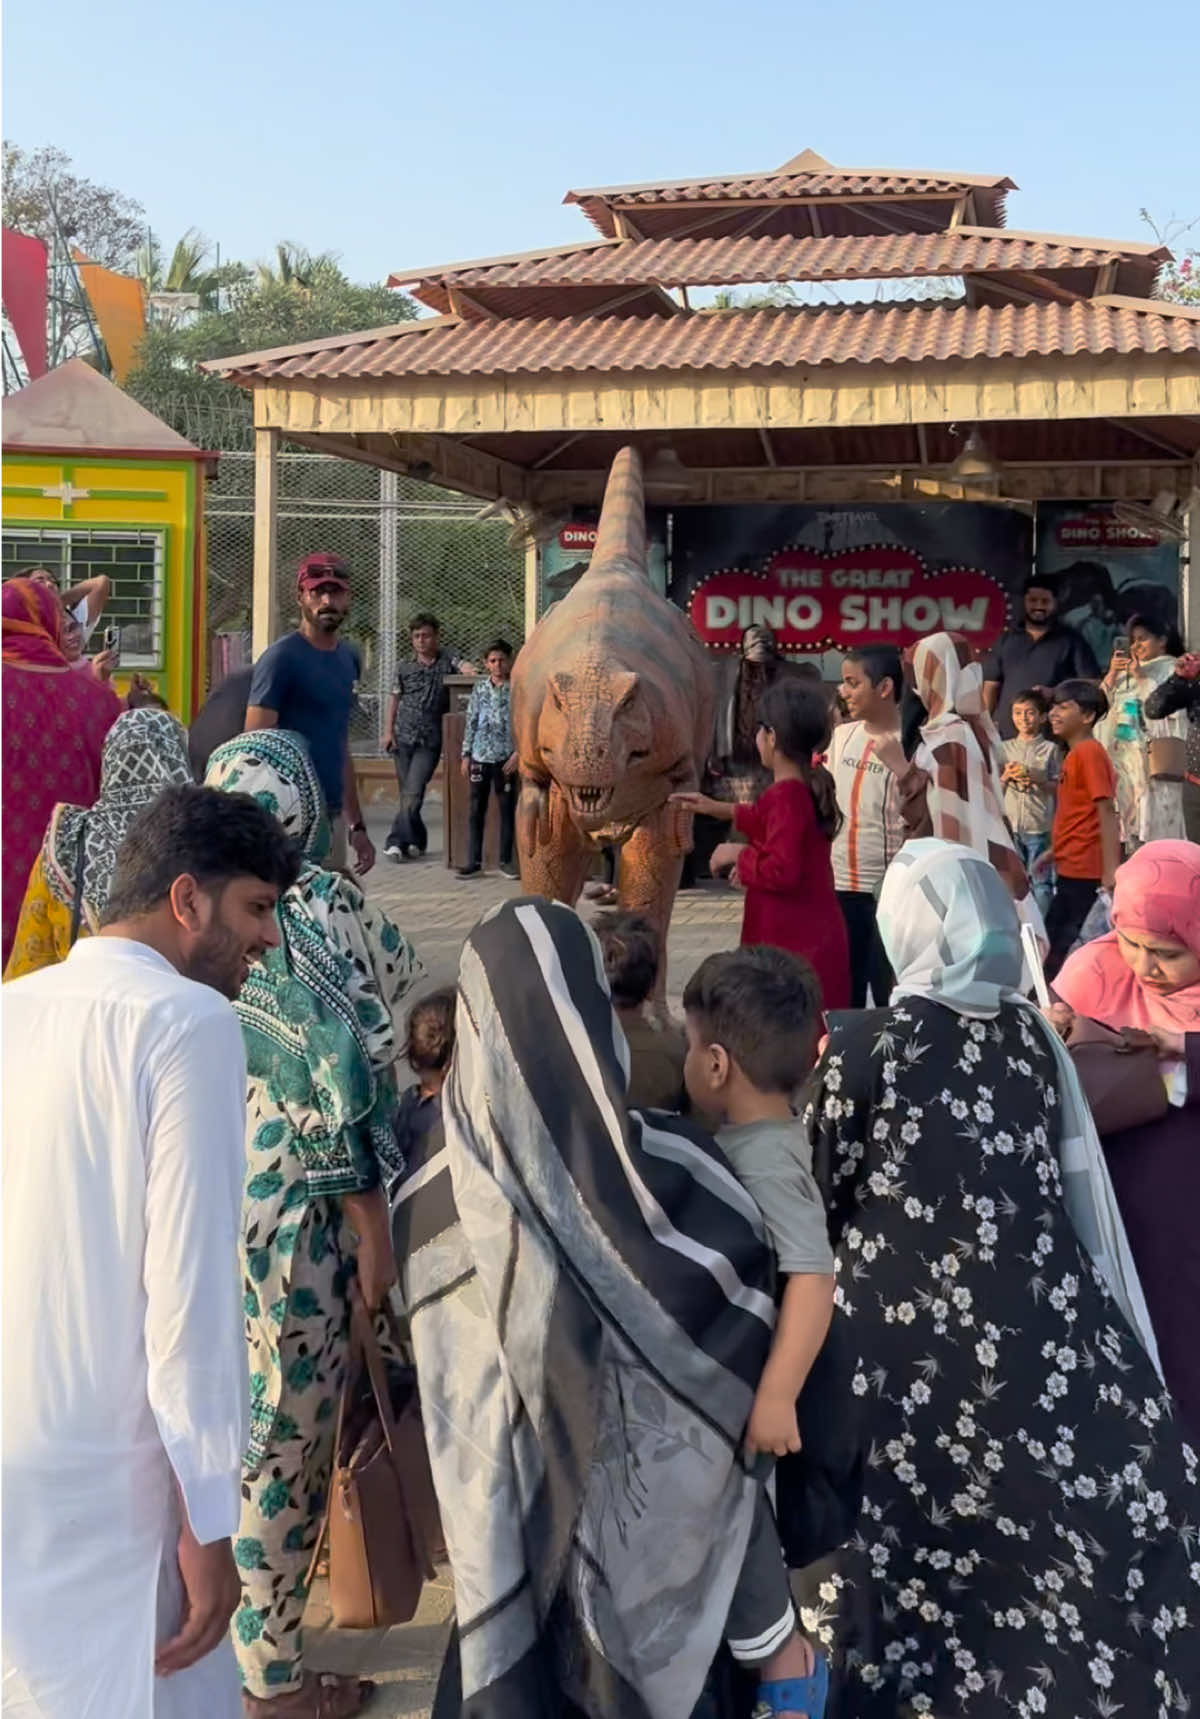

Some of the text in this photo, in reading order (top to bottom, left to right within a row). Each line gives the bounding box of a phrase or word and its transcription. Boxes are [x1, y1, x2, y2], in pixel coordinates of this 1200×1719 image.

[563, 530, 599, 542] DINO
[1061, 527, 1101, 540] DINO
[777, 568, 914, 589] THE GREAT
[706, 595, 990, 631] DINO SHOW
